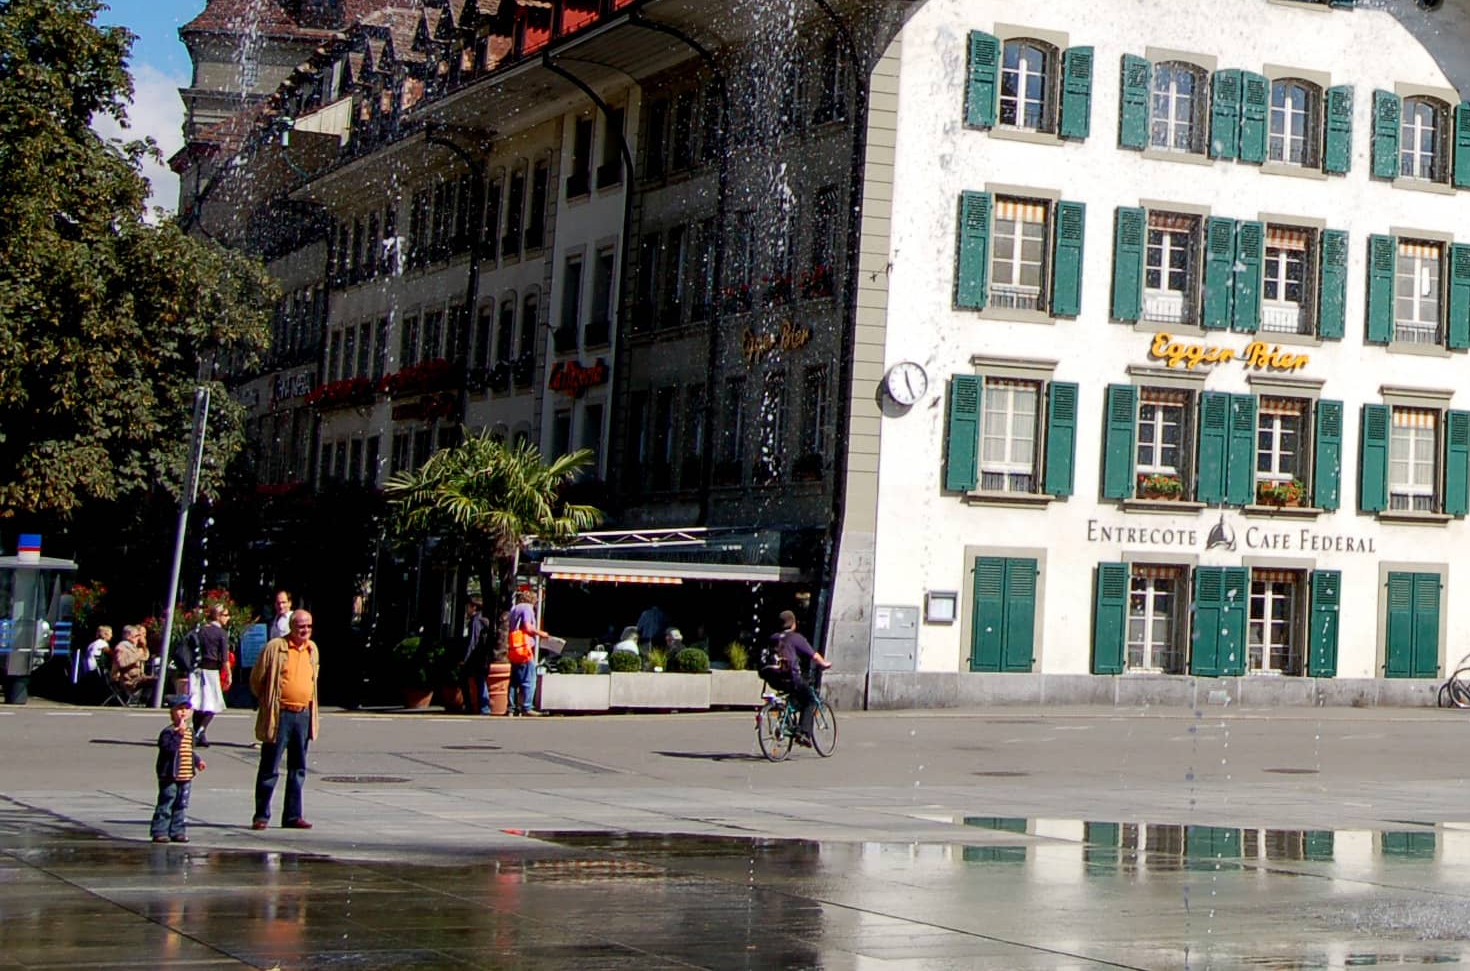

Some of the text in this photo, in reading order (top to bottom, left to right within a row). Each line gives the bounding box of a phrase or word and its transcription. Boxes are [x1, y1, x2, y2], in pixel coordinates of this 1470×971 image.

[1151, 332, 1310, 370] Egger Bier
[1087, 519, 1377, 553] ENTRECOTE CAFE FEDERAL
